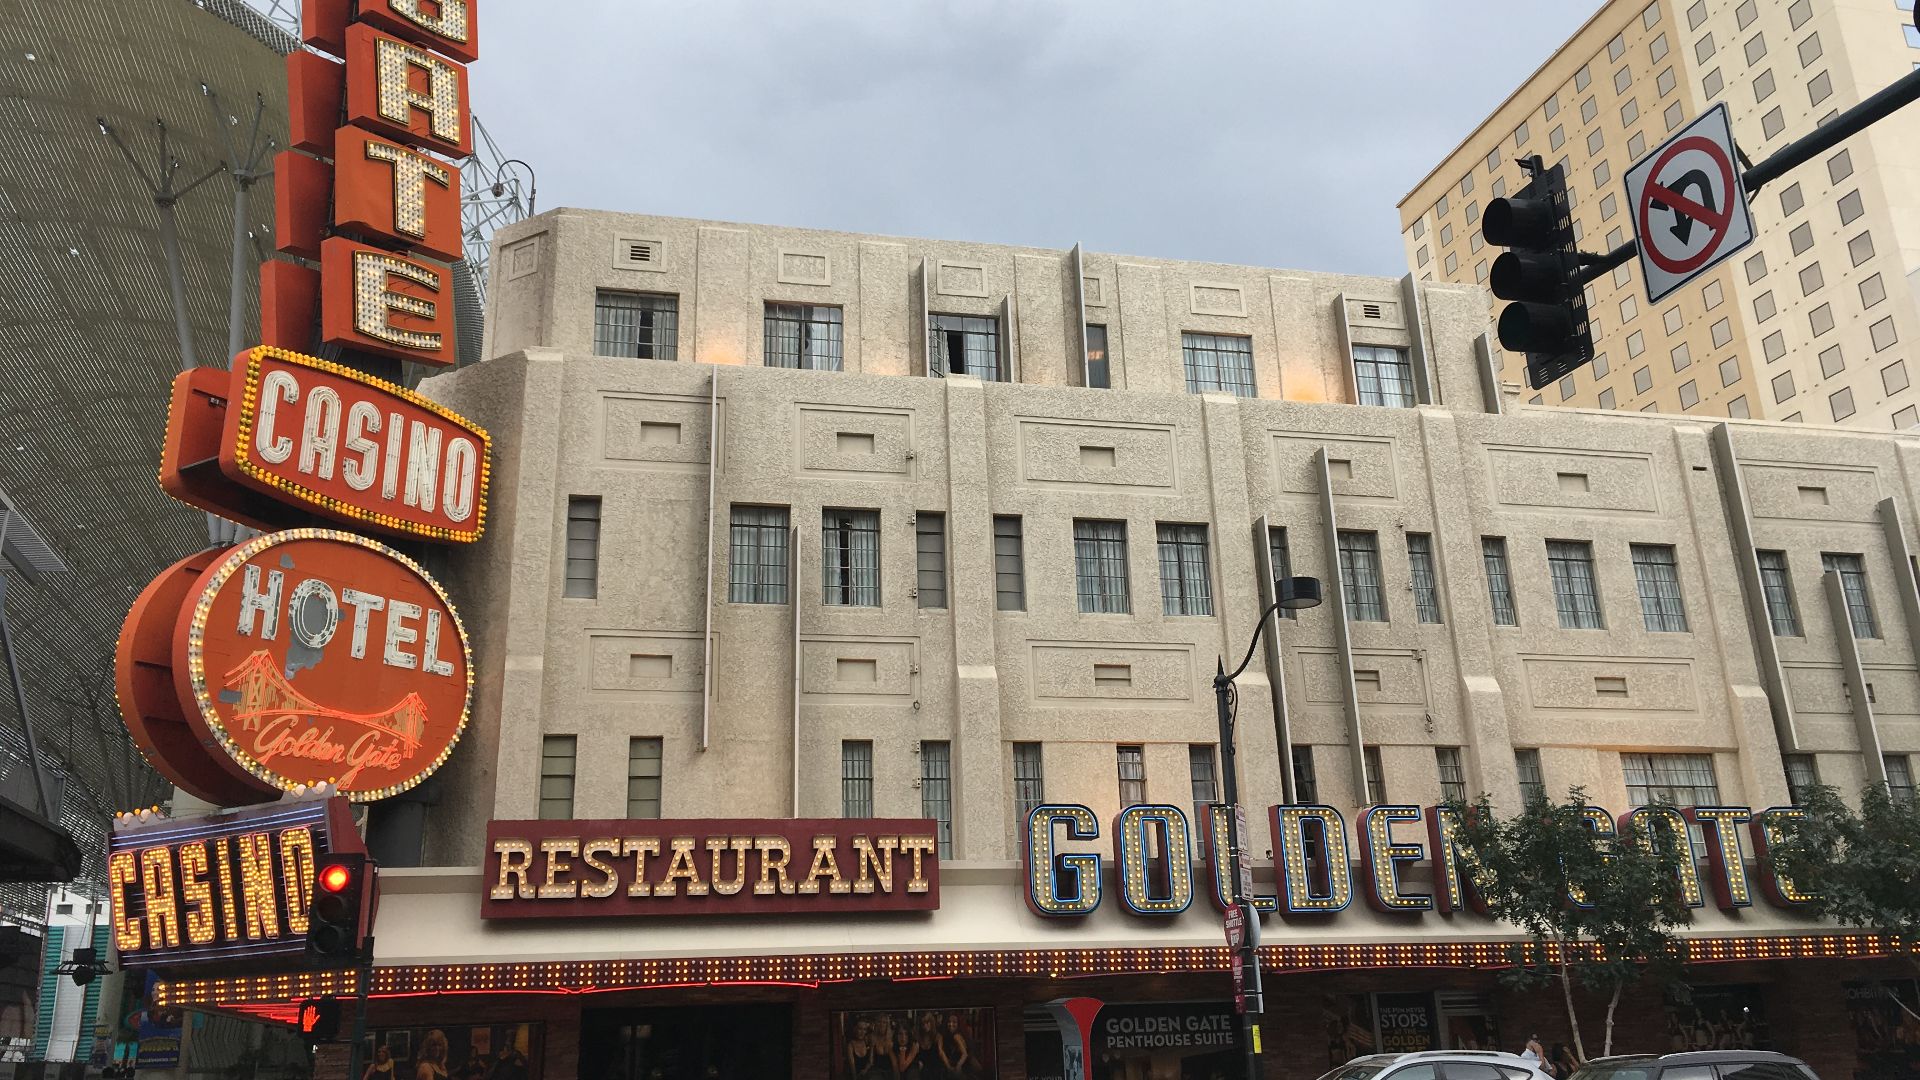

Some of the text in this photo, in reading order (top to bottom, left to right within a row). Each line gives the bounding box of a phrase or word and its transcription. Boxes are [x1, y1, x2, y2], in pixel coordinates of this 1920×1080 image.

[255, 370, 478, 523] CASINO
[237, 563, 456, 677] HOTEL
[253, 714, 404, 790] Golden Gate
[490, 835, 935, 901] RESTAURANT
[109, 826, 315, 952] CASINO
[1226, 917, 1242, 928] SHUTTLE
[1228, 909, 1238, 919] FREE
[1106, 1014, 1231, 1034] GOLDEN GATE
[1381, 1013, 1428, 1028] STOPS
[1107, 1031, 1234, 1048] PENTHOUSE SUITE
[1383, 1034, 1431, 1046] GOLDEN
